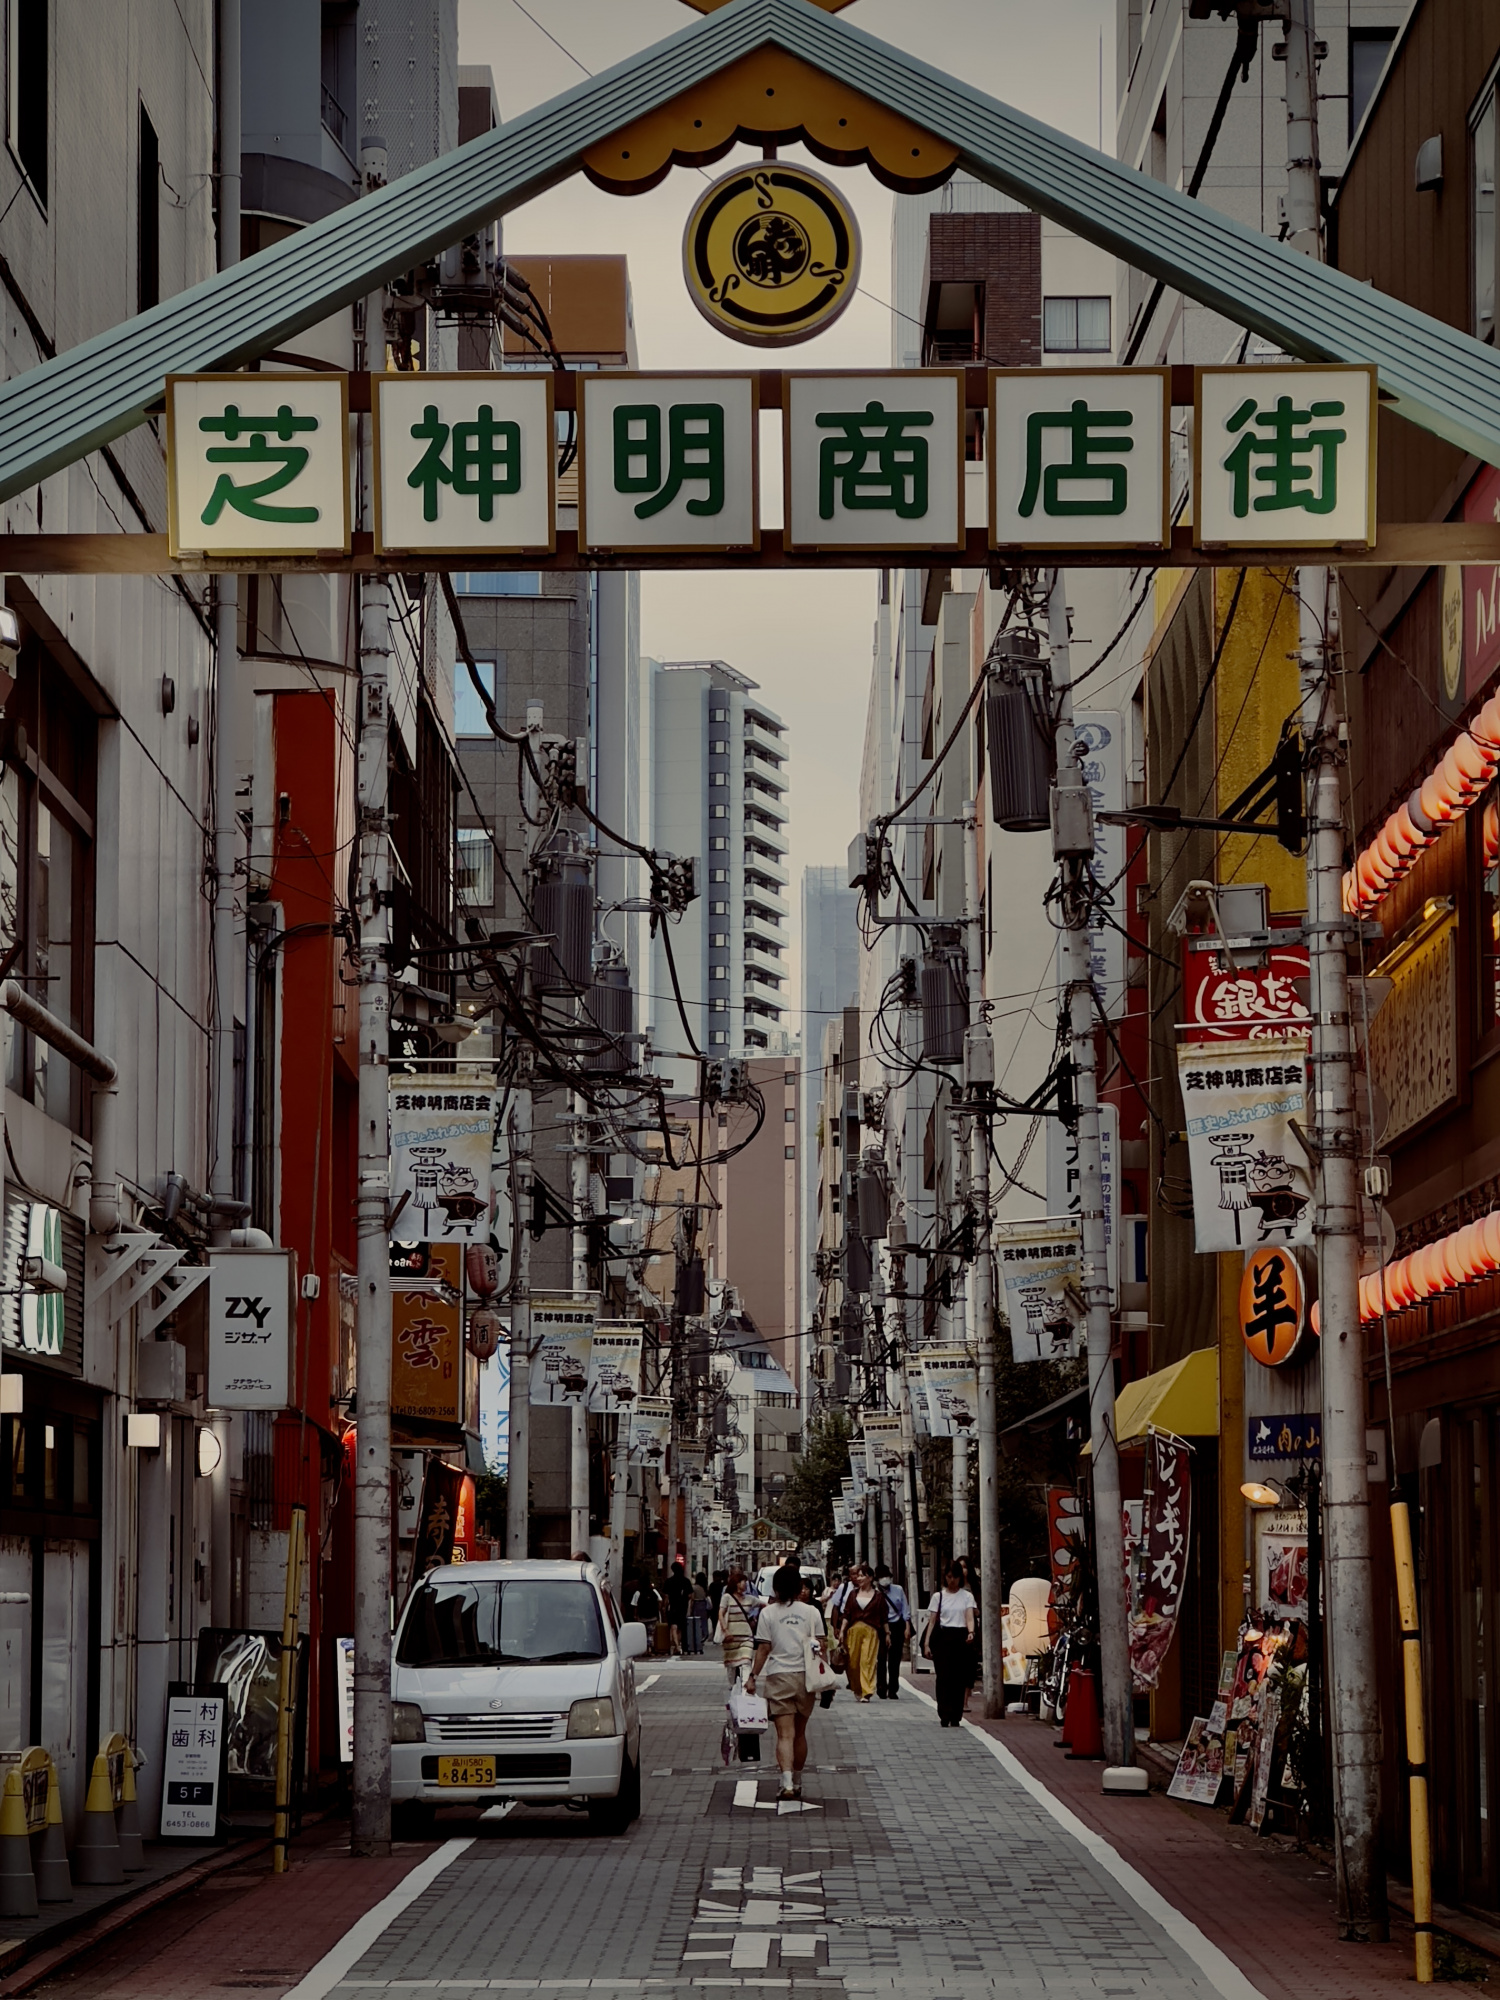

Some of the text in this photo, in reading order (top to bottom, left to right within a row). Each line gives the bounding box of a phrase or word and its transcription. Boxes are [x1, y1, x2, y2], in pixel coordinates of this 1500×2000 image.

[199, 396, 1346, 526] 芝神明商店街
[1186, 1065, 1303, 1091] 芝神明商店会
[395, 1095, 491, 1111] 芝神明商店会
[1188, 1094, 1304, 1136] 歴史とふれあいの街
[394, 1119, 490, 1147] 歴史とふれあいの街
[225, 1297, 271, 1328] ZXY
[1245, 1254, 1298, 1354] 羊
[474, 1324, 488, 1345] 酒
[172, 1729, 217, 1748] 歯科
[451, 1768, 493, 1783] 84-59
